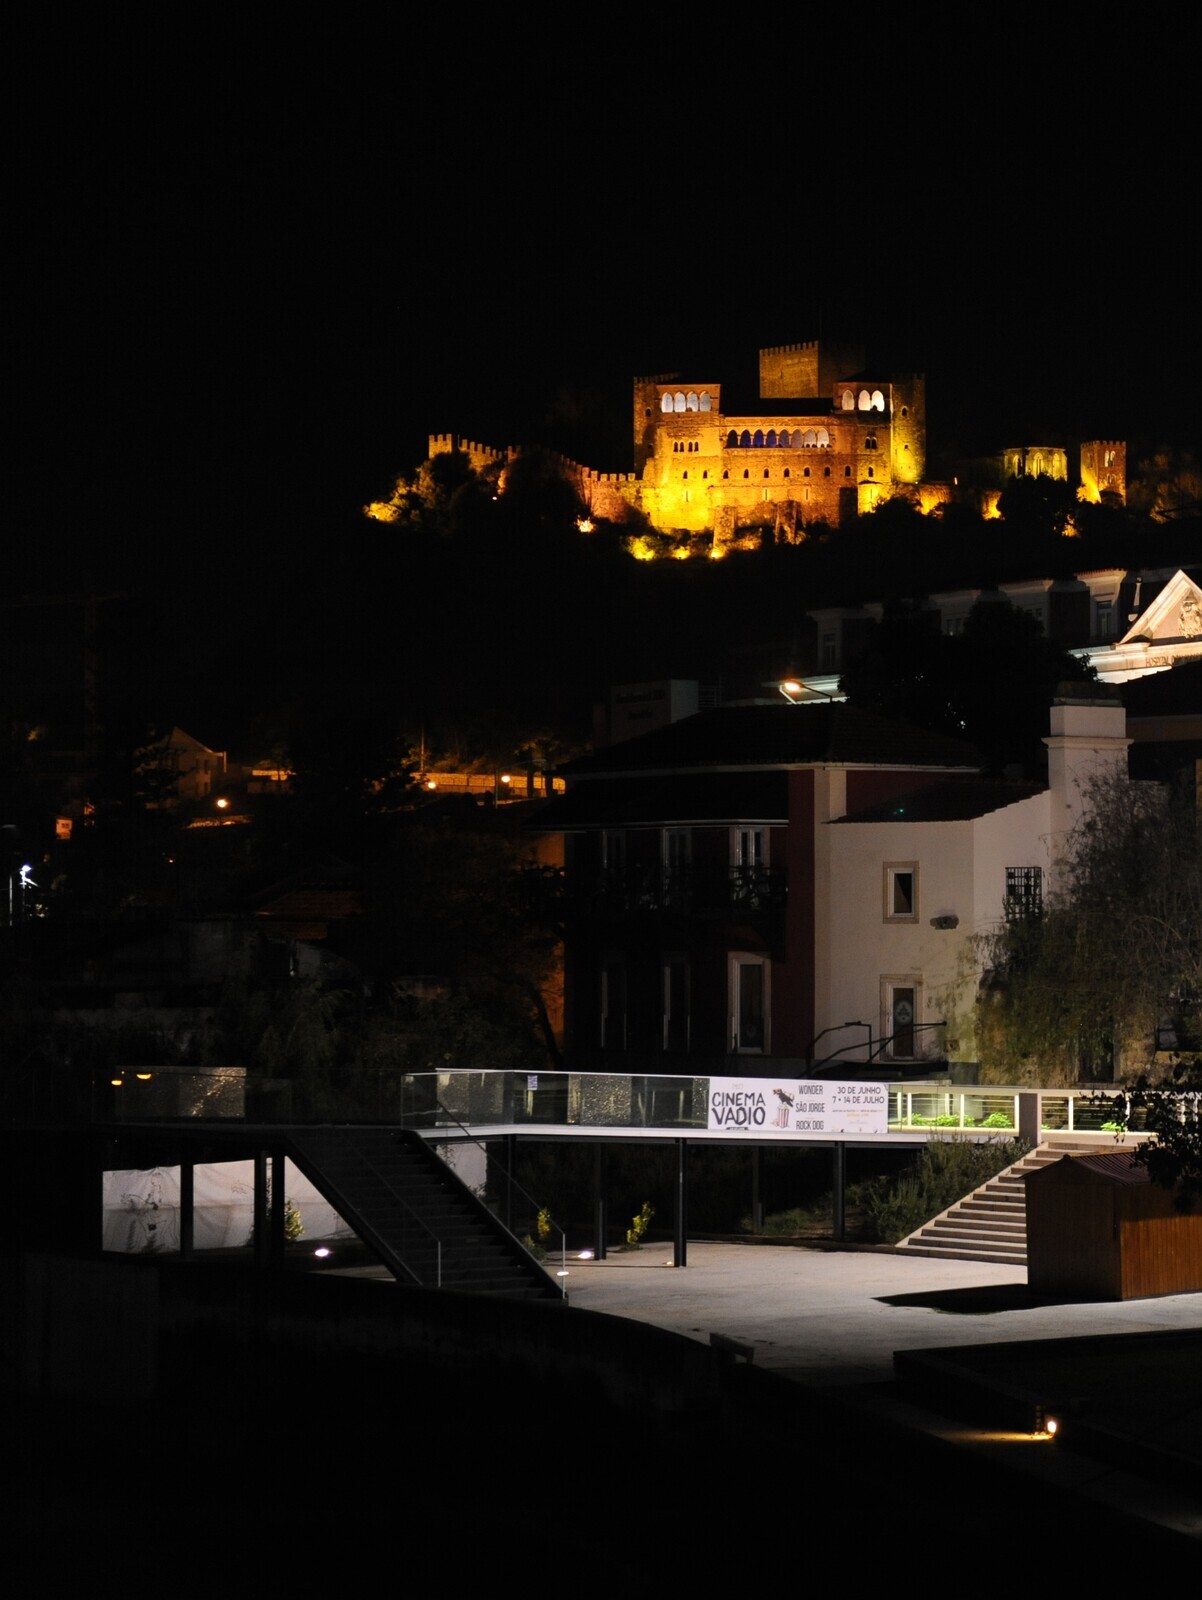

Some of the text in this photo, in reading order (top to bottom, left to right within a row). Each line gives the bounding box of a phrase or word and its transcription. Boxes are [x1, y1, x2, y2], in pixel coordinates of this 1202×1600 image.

[798, 1085, 824, 1095] WONDER
[837, 1086, 881, 1095] 30 DE JUNHO
[712, 1092, 766, 1107] CINEMA
[832, 1096, 885, 1104] 7 14 DE JULHO
[796, 1101, 825, 1112] SÃO JORGE
[711, 1106, 766, 1125] VADIO
[795, 1120, 824, 1130] ROCK DOG
